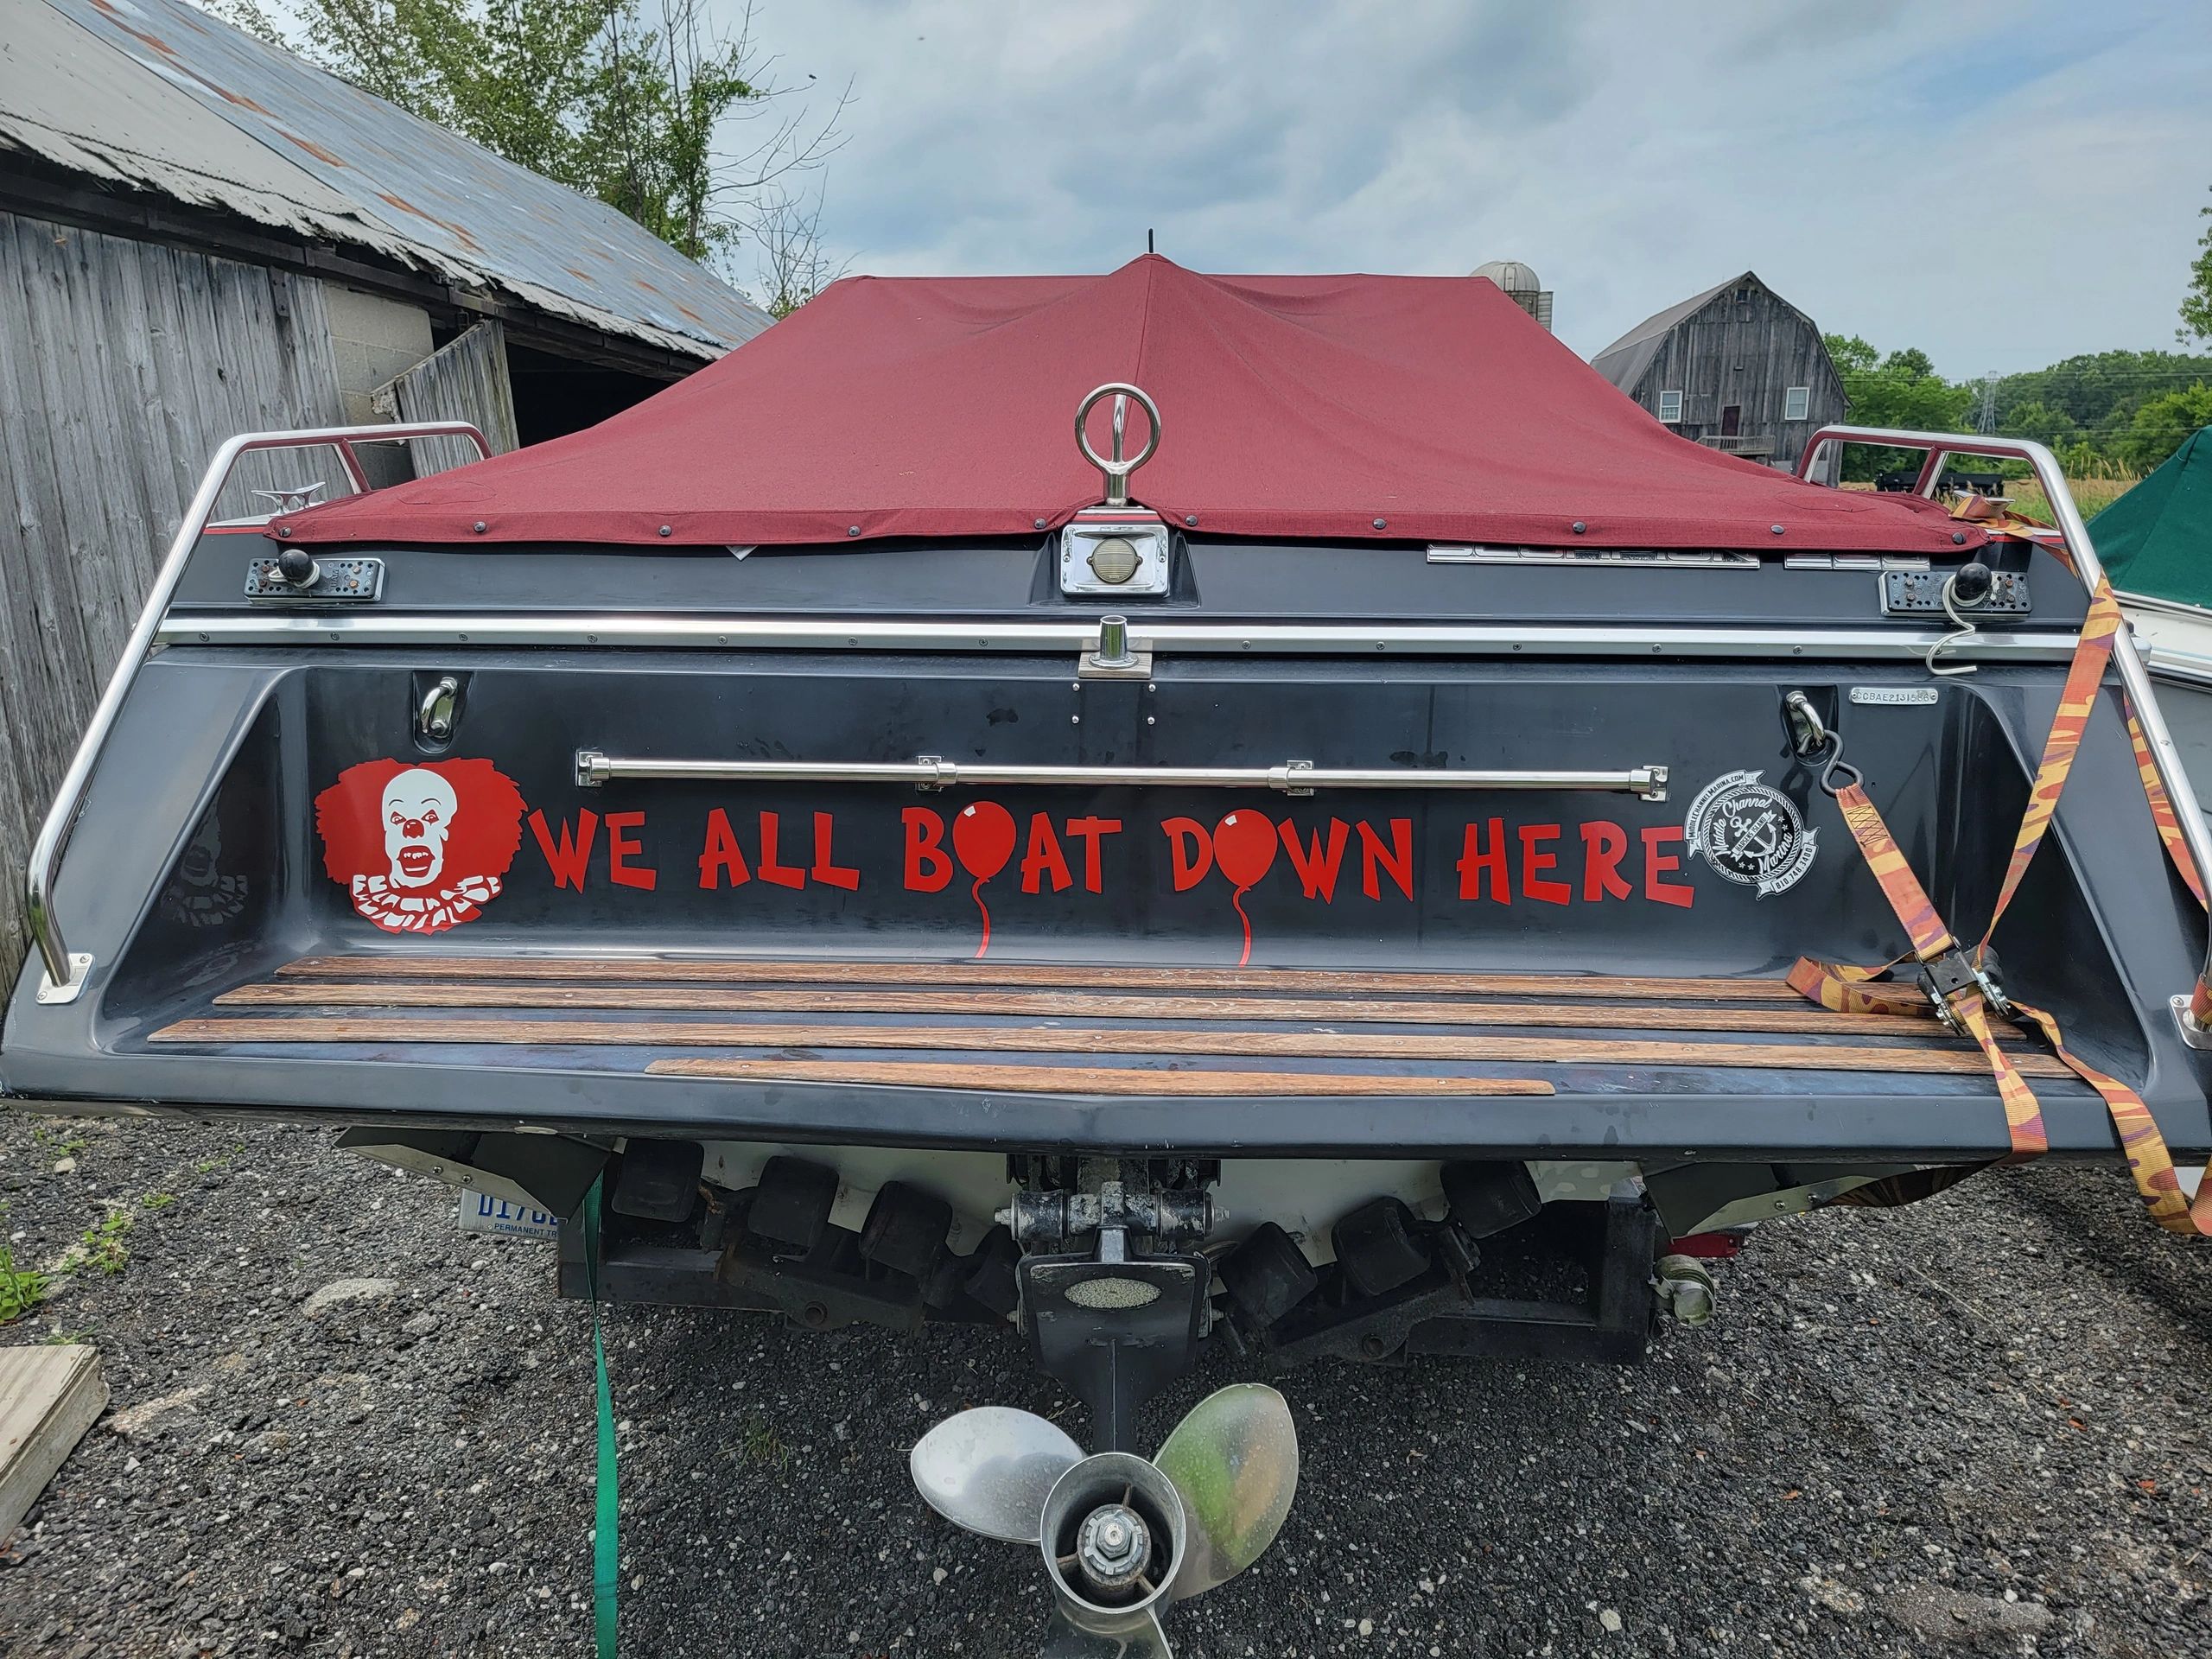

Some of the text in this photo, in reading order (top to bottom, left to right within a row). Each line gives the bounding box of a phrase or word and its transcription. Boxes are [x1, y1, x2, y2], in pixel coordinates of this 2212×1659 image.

[1712, 798, 1794, 874] Middle Channel Marina
[1751, 816, 1767, 834] ISLAND
[528, 801, 1694, 909] WE ALL BOAT DOWN HERE
[493, 1223, 544, 1236] PERMANENT
